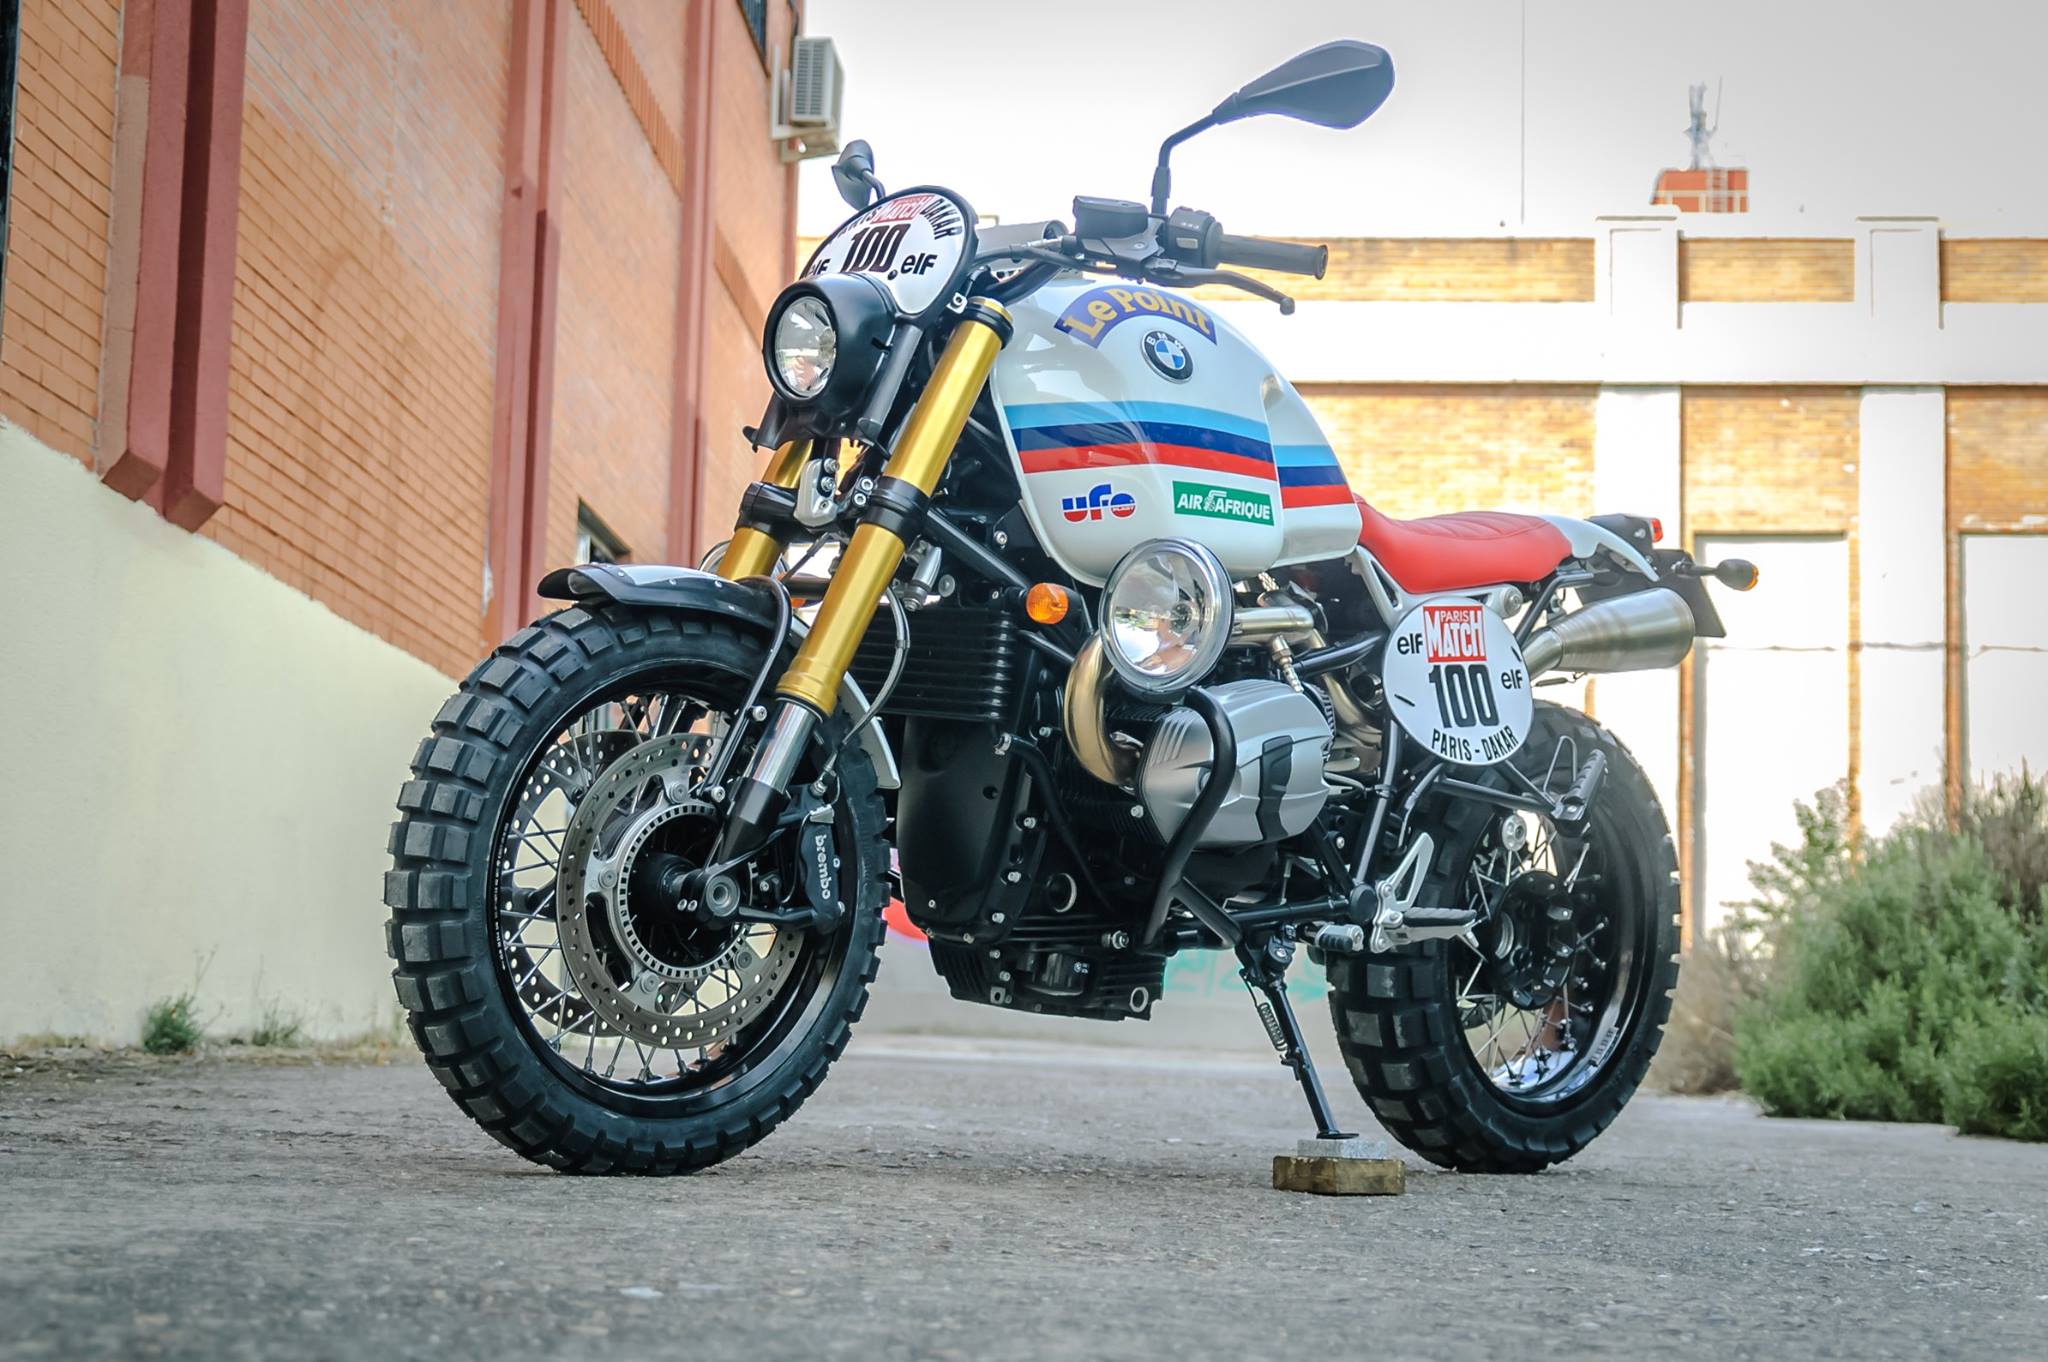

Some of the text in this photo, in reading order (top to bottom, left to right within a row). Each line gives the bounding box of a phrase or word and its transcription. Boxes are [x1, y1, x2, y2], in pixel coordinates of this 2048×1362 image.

[873, 196, 934, 223] MATCH
[920, 198, 962, 240] DAKAR
[841, 225, 911, 273] 100
[901, 253, 938, 275] elf
[1063, 287, 1211, 340] Le Point
[1146, 332, 1185, 349] BMW
[1177, 494, 1271, 520] AIR AFRIQUE
[1441, 611, 1469, 622] PARIS
[1397, 633, 1423, 655] elf
[1424, 610, 1485, 658] MATCH
[1501, 669, 1523, 690] elf
[1428, 664, 1500, 728] 100
[1431, 728, 1472, 761] PARIS
[1481, 725, 1519, 761] DAKAR
[815, 834, 833, 900] brembo
